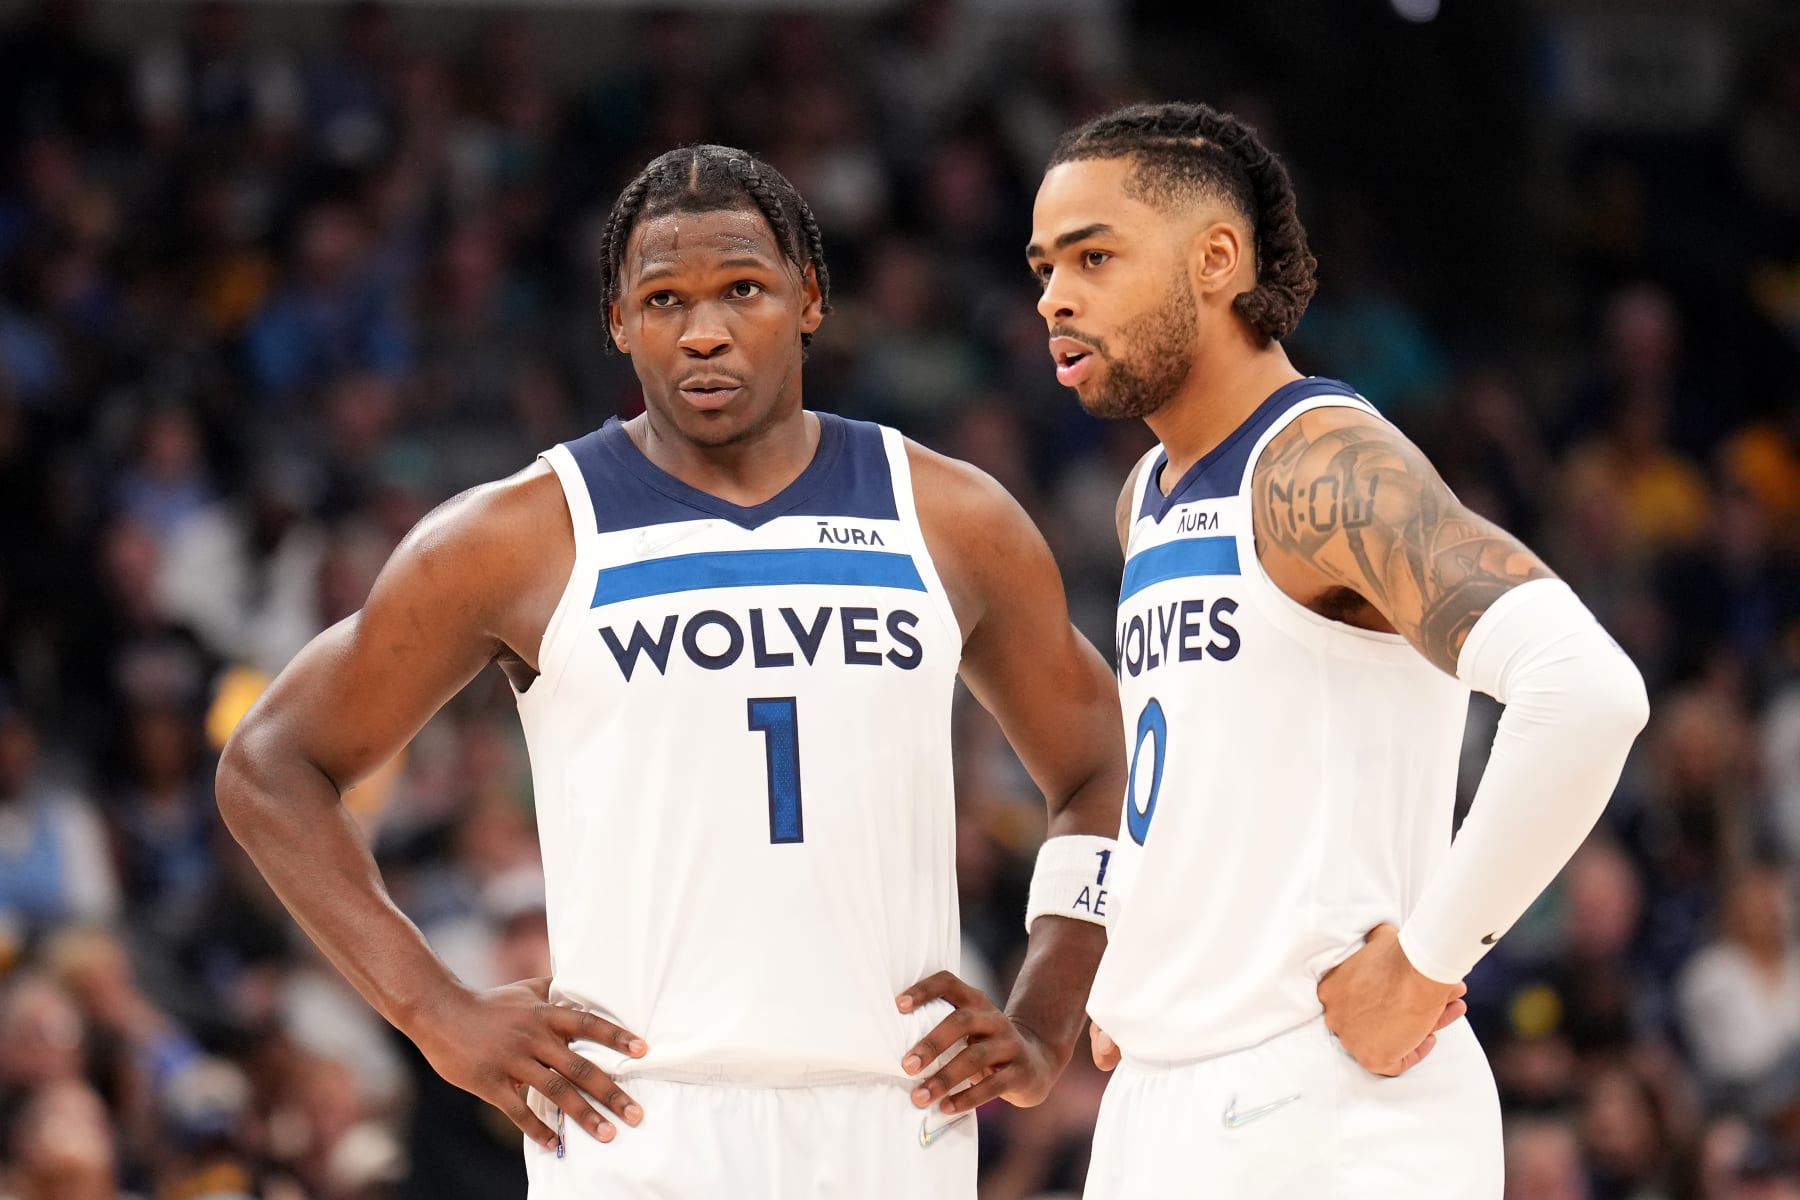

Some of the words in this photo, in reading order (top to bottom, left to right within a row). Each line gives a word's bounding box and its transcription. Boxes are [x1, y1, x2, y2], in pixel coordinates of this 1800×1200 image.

[598, 606, 923, 683] WOLVES
[747, 696, 804, 844] 1
[1126, 697, 1167, 847] 0
[1095, 849, 1111, 886] 1
